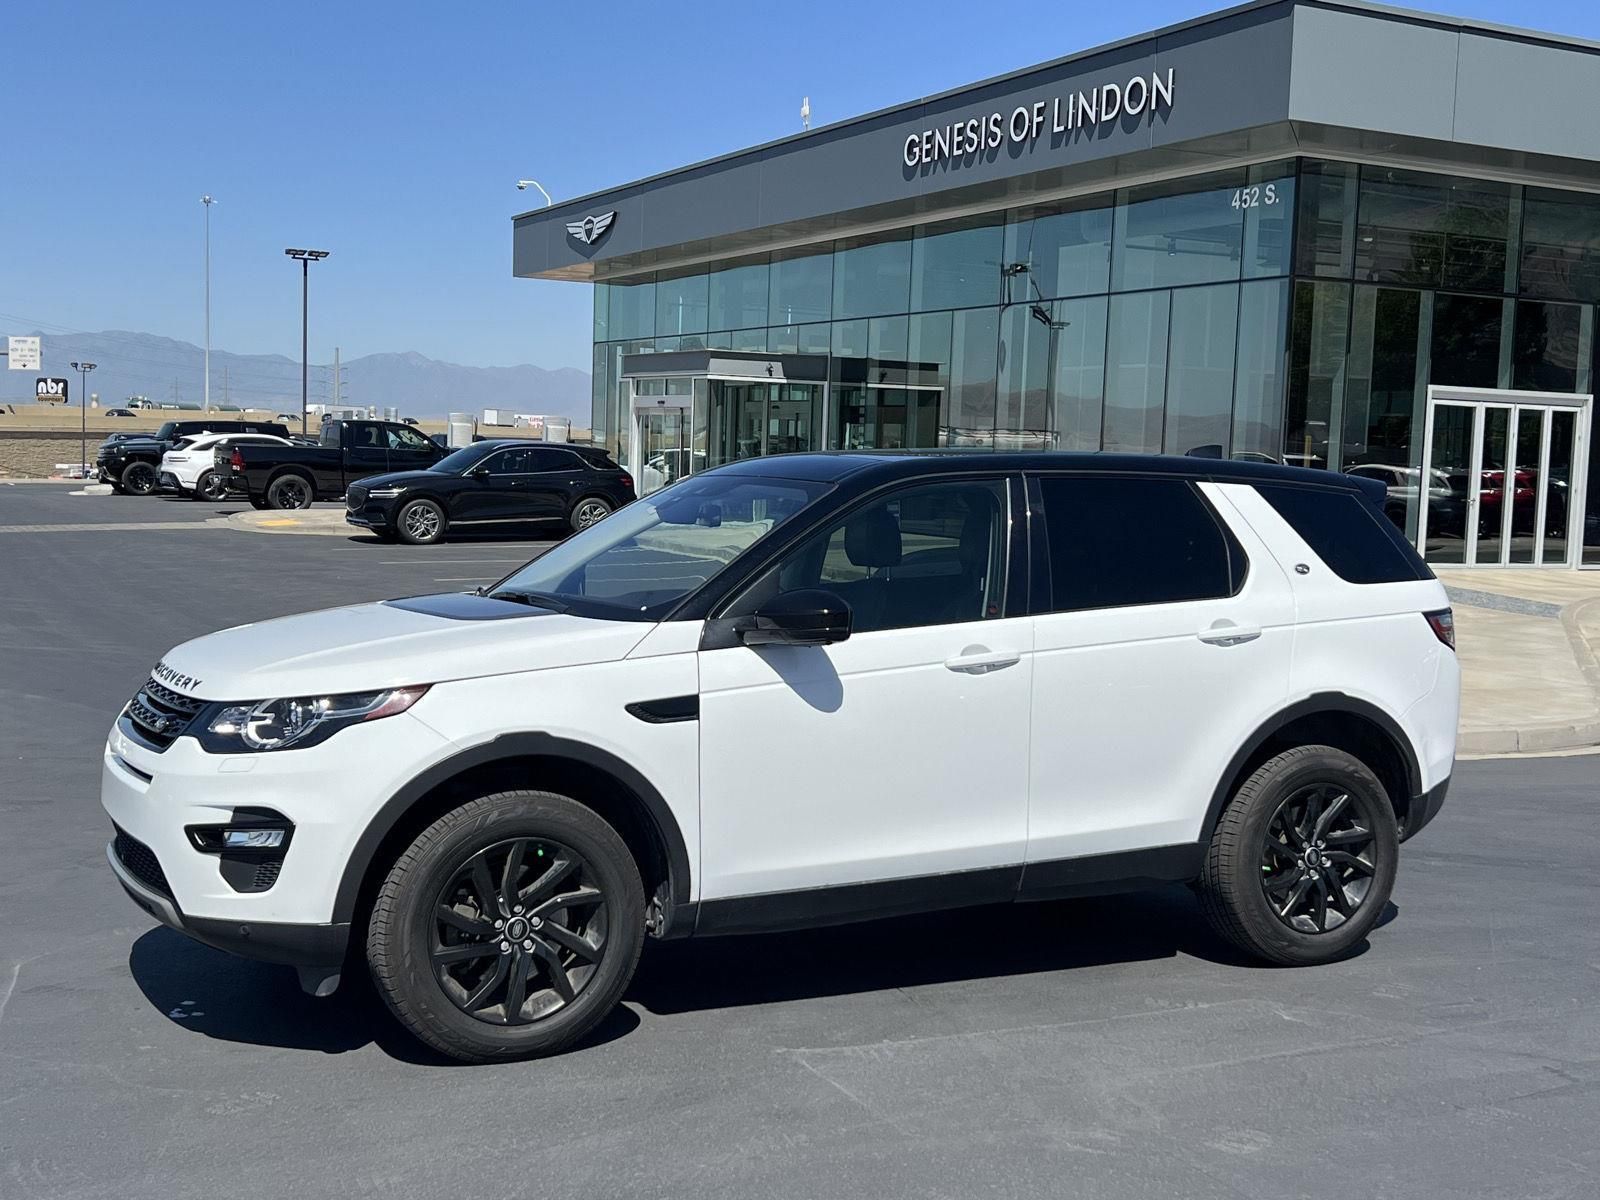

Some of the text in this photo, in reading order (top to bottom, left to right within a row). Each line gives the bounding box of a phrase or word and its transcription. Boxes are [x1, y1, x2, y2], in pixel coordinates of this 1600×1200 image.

[903, 68, 1174, 167] GENESIS OF LINDON
[1231, 183, 1280, 210] 452 S.
[37, 378, 64, 394] nbr
[153, 661, 203, 691] SCOVERY
